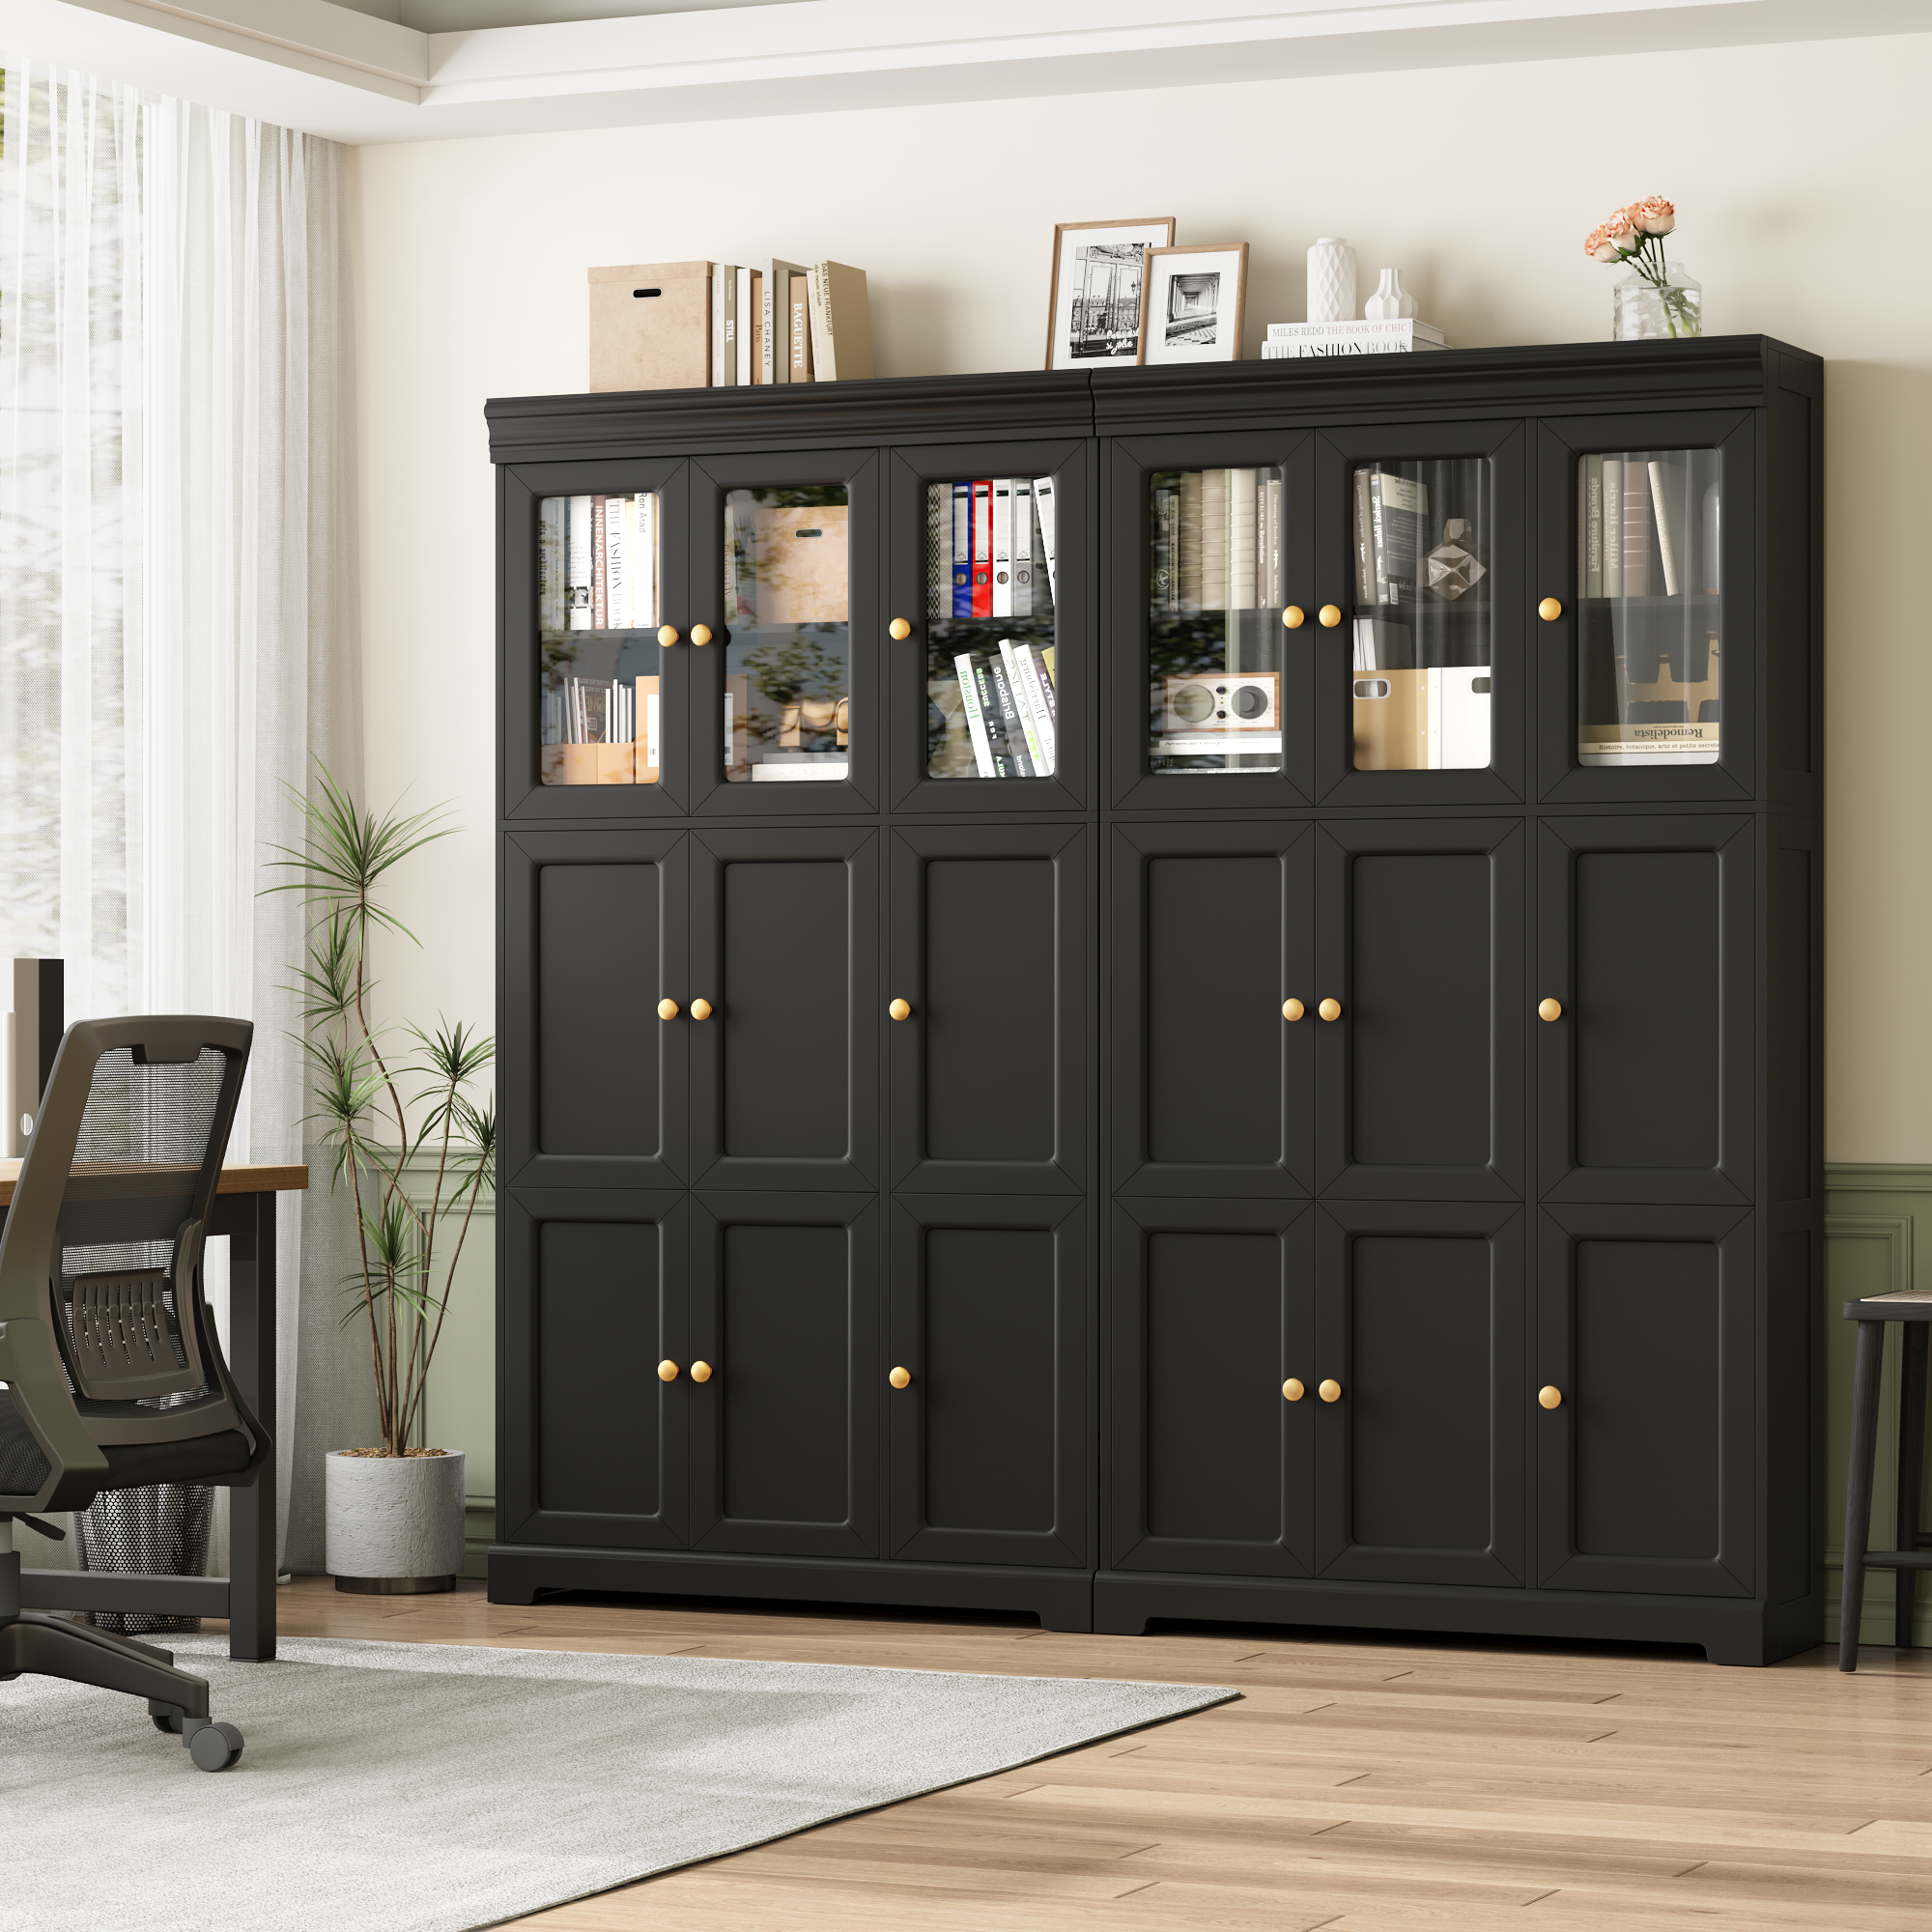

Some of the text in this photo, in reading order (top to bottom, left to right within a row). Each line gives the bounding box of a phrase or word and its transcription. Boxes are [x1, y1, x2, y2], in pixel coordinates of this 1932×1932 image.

[793, 302, 804, 369] BAGUETTE
[824, 298, 834, 336] FRANKFURT
[1272, 323, 1406, 337] MILES REDD THE BOOK OF CHIC
[1264, 340, 1408, 359] THE FASHION BOOK
[639, 493, 647, 533] Ron Arad
[595, 505, 604, 626] INNENARCHITEKTUR
[610, 532, 622, 589] FASHION
[1634, 728, 1703, 740] Remodelista
